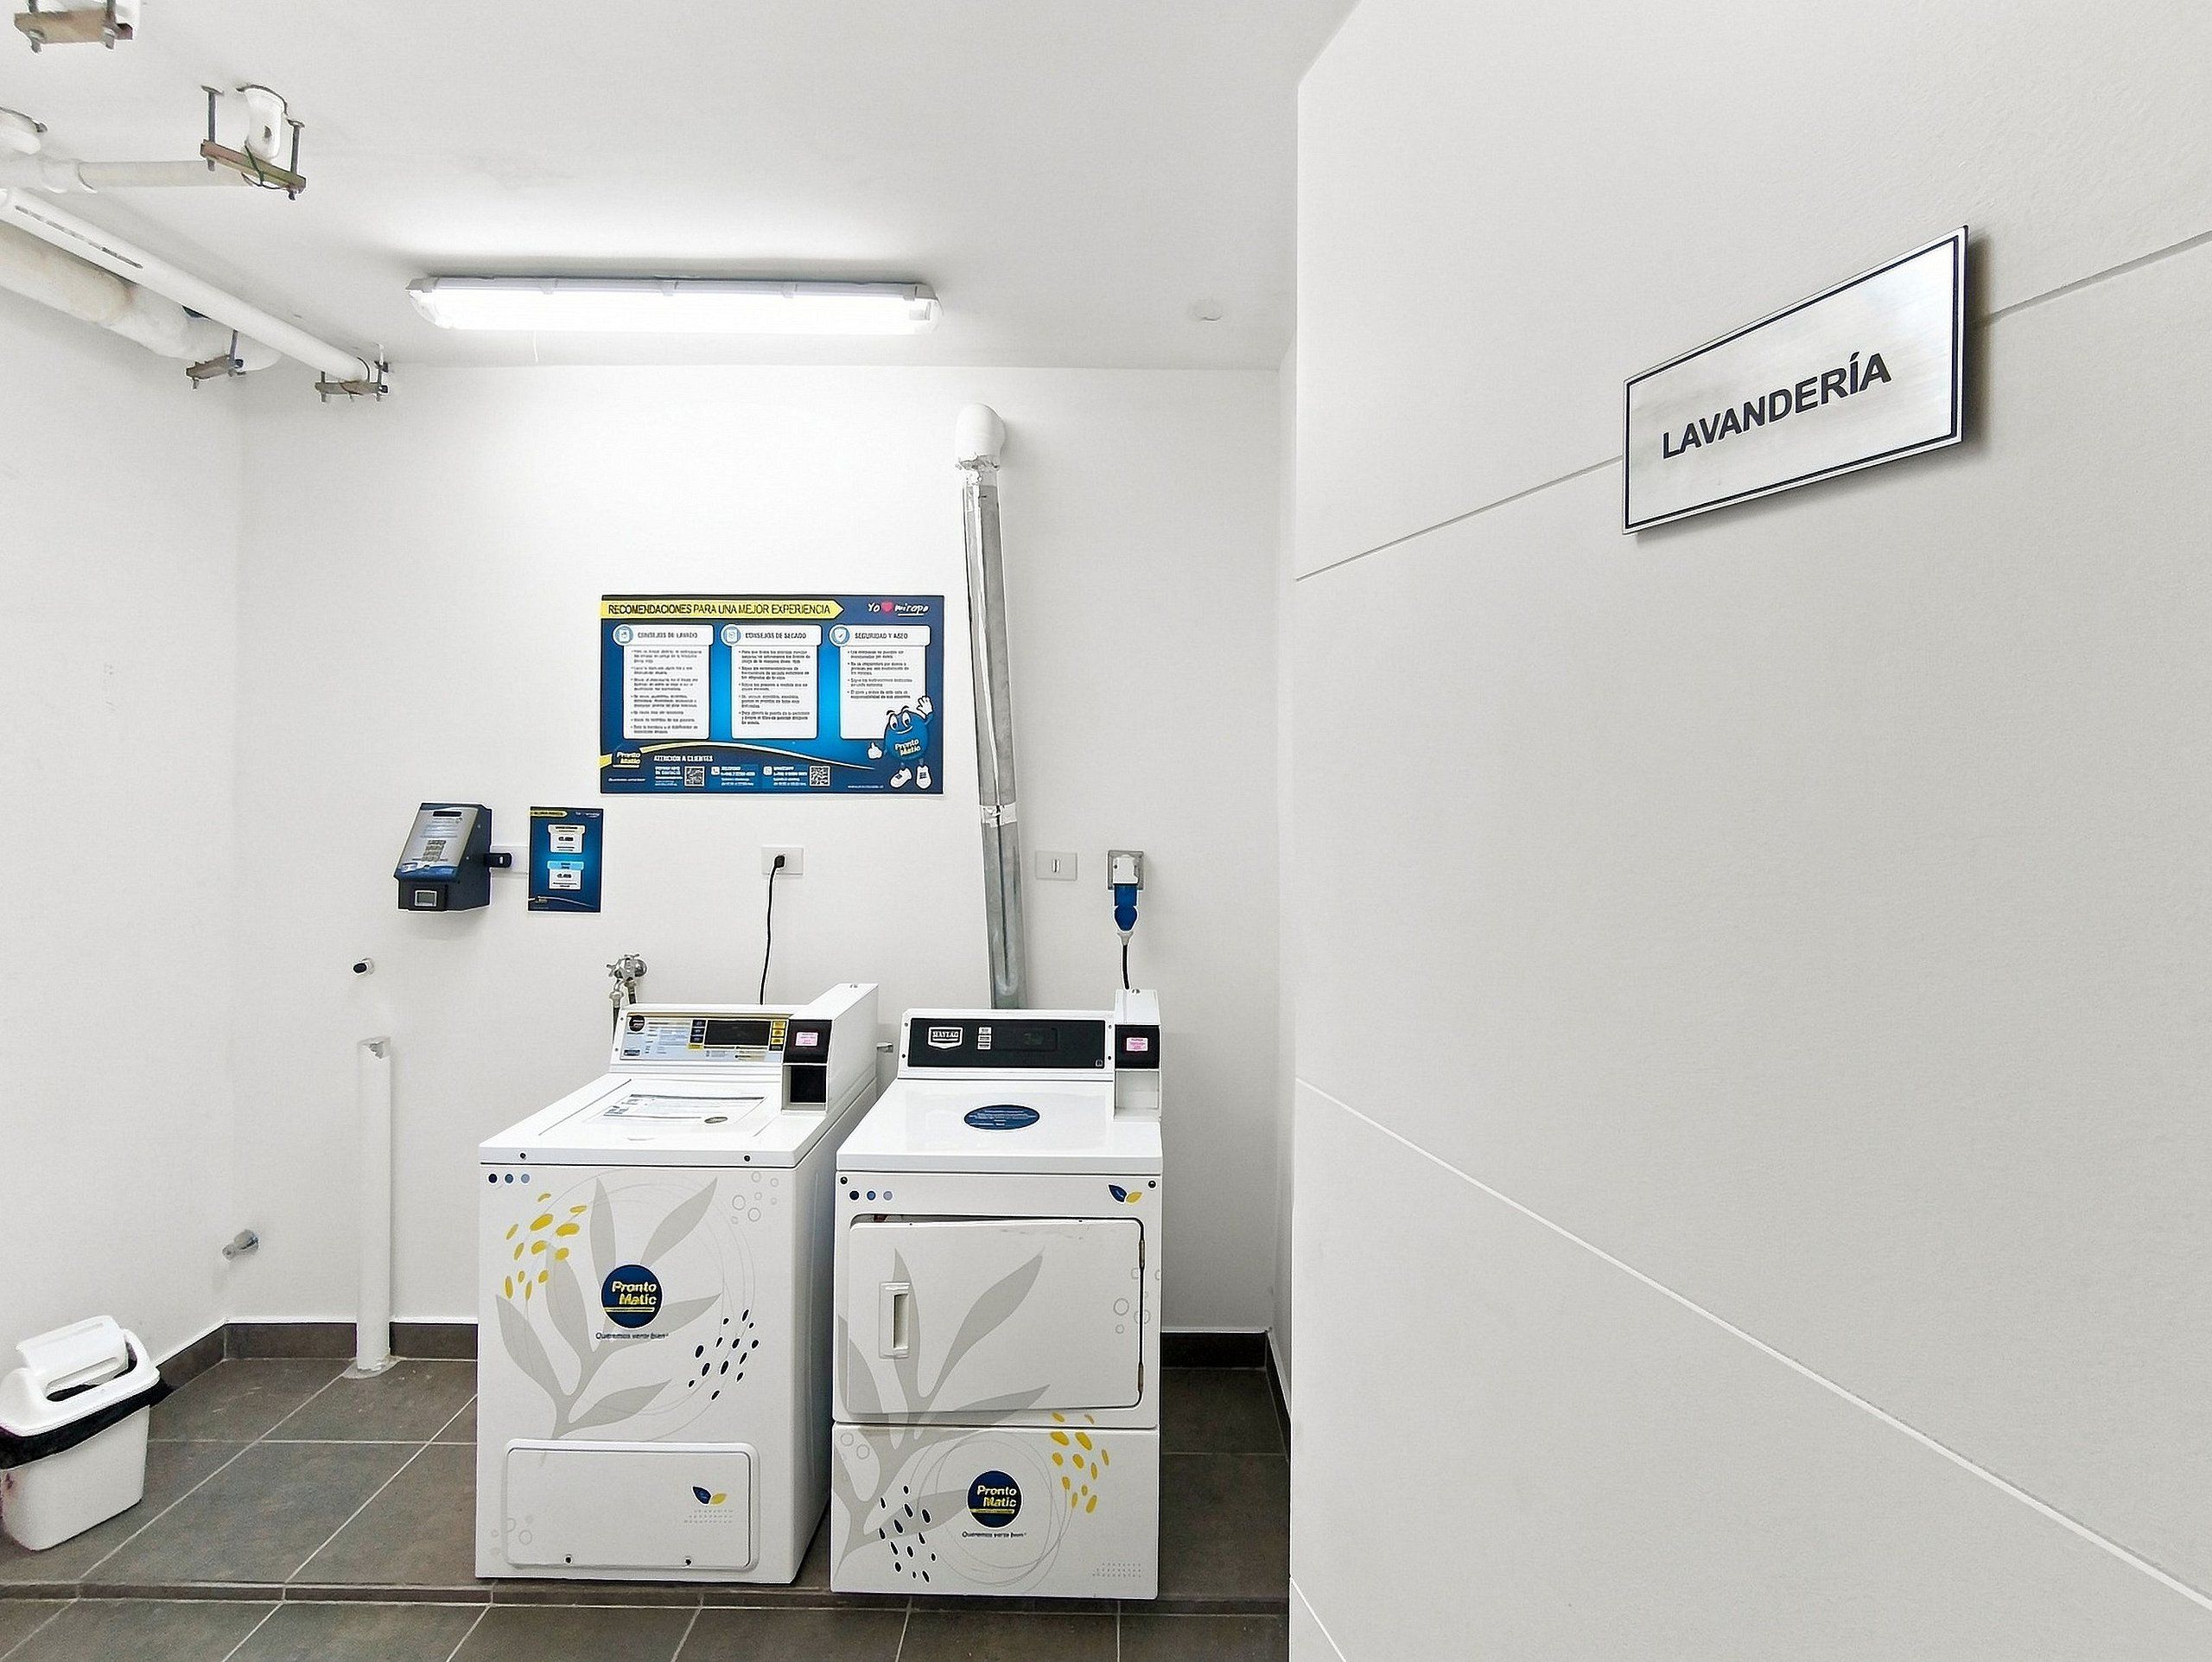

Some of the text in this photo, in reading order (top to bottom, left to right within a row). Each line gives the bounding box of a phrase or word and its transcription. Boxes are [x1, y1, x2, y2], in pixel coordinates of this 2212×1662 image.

[1662, 351, 1892, 460] LAVANDERÍA
[608, 604, 830, 614] RECOMENDACIONES PARA UNA MEJOR EXPERIENCIA
[868, 602, 880, 613] Yo
[612, 1281, 658, 1293] Pronto
[620, 1293, 658, 1305] Matic
[977, 1485, 1017, 1496] Pronto
[983, 1497, 1017, 1507] Matic
